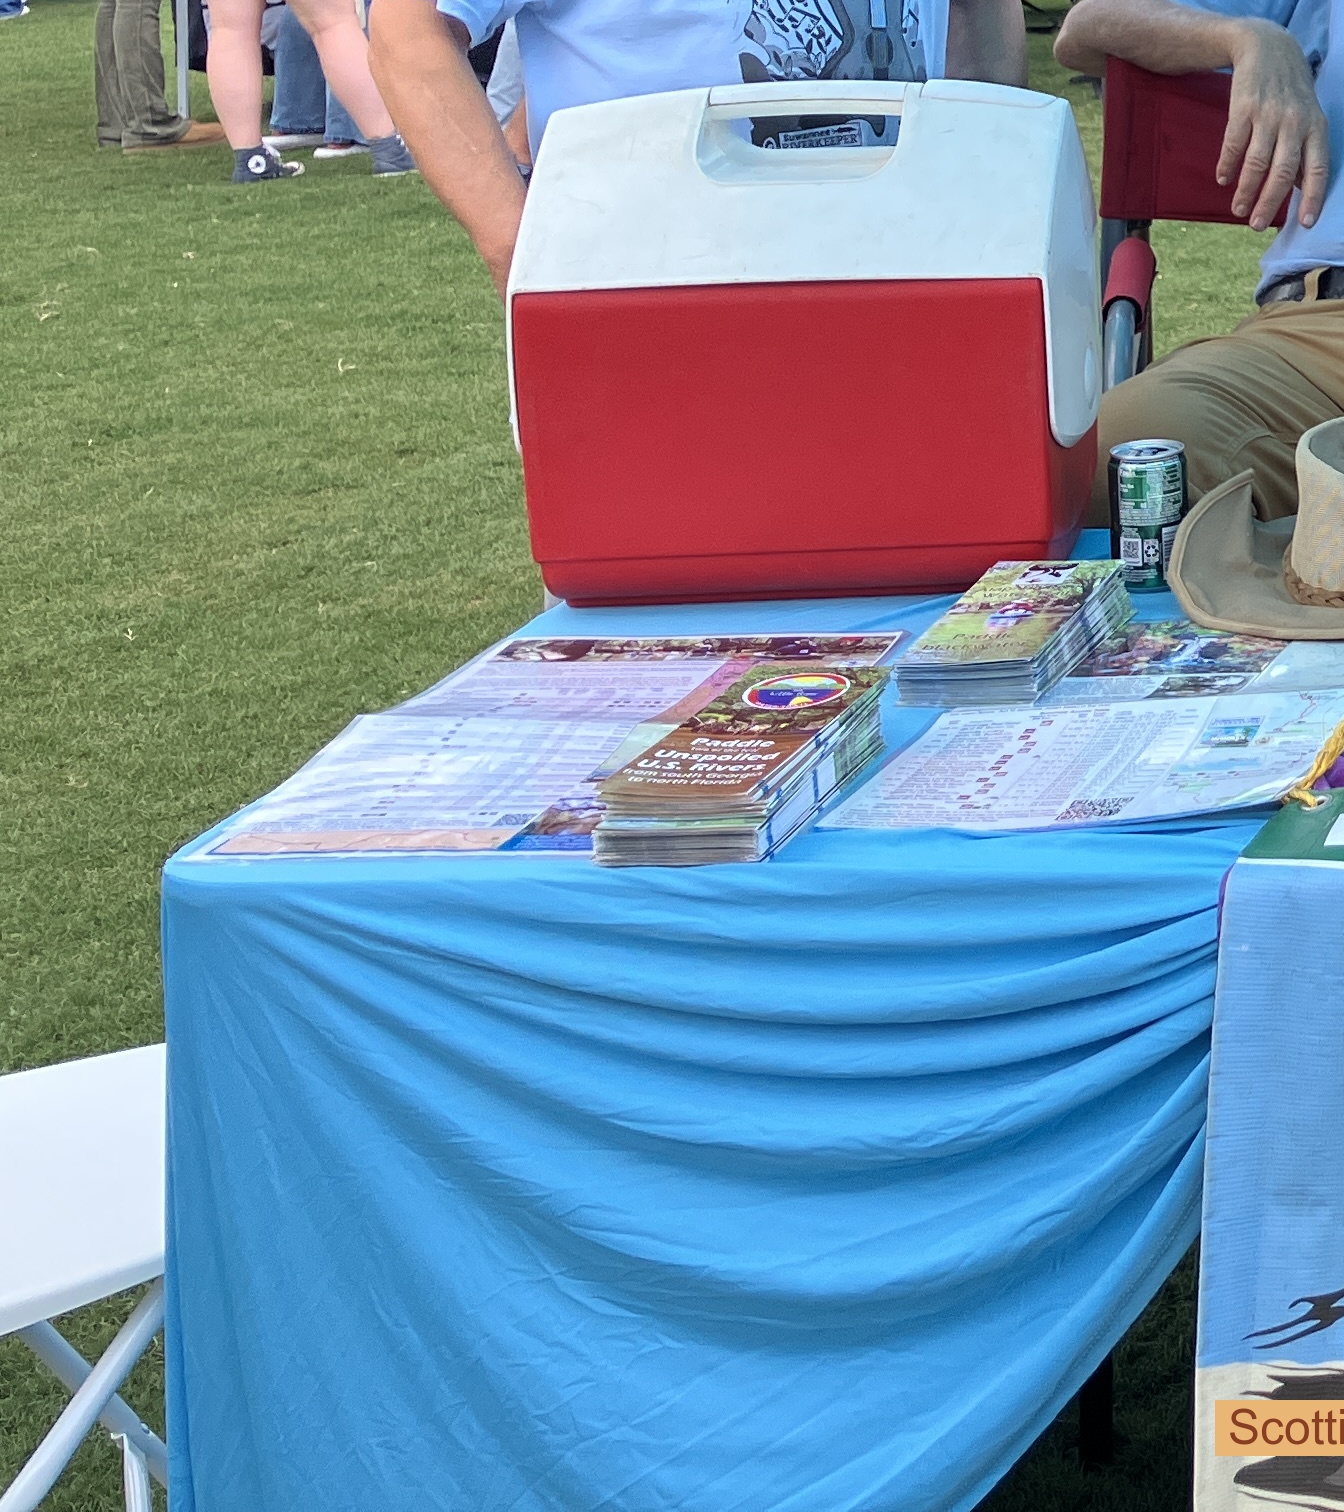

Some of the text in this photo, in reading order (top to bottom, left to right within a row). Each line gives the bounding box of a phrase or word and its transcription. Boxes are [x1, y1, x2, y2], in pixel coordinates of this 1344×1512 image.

[690, 737, 776, 748] Paddle
[654, 749, 781, 762] Unspoiled
[636, 759, 767, 771] U.S. Rivers
[623, 768, 658, 777] from
